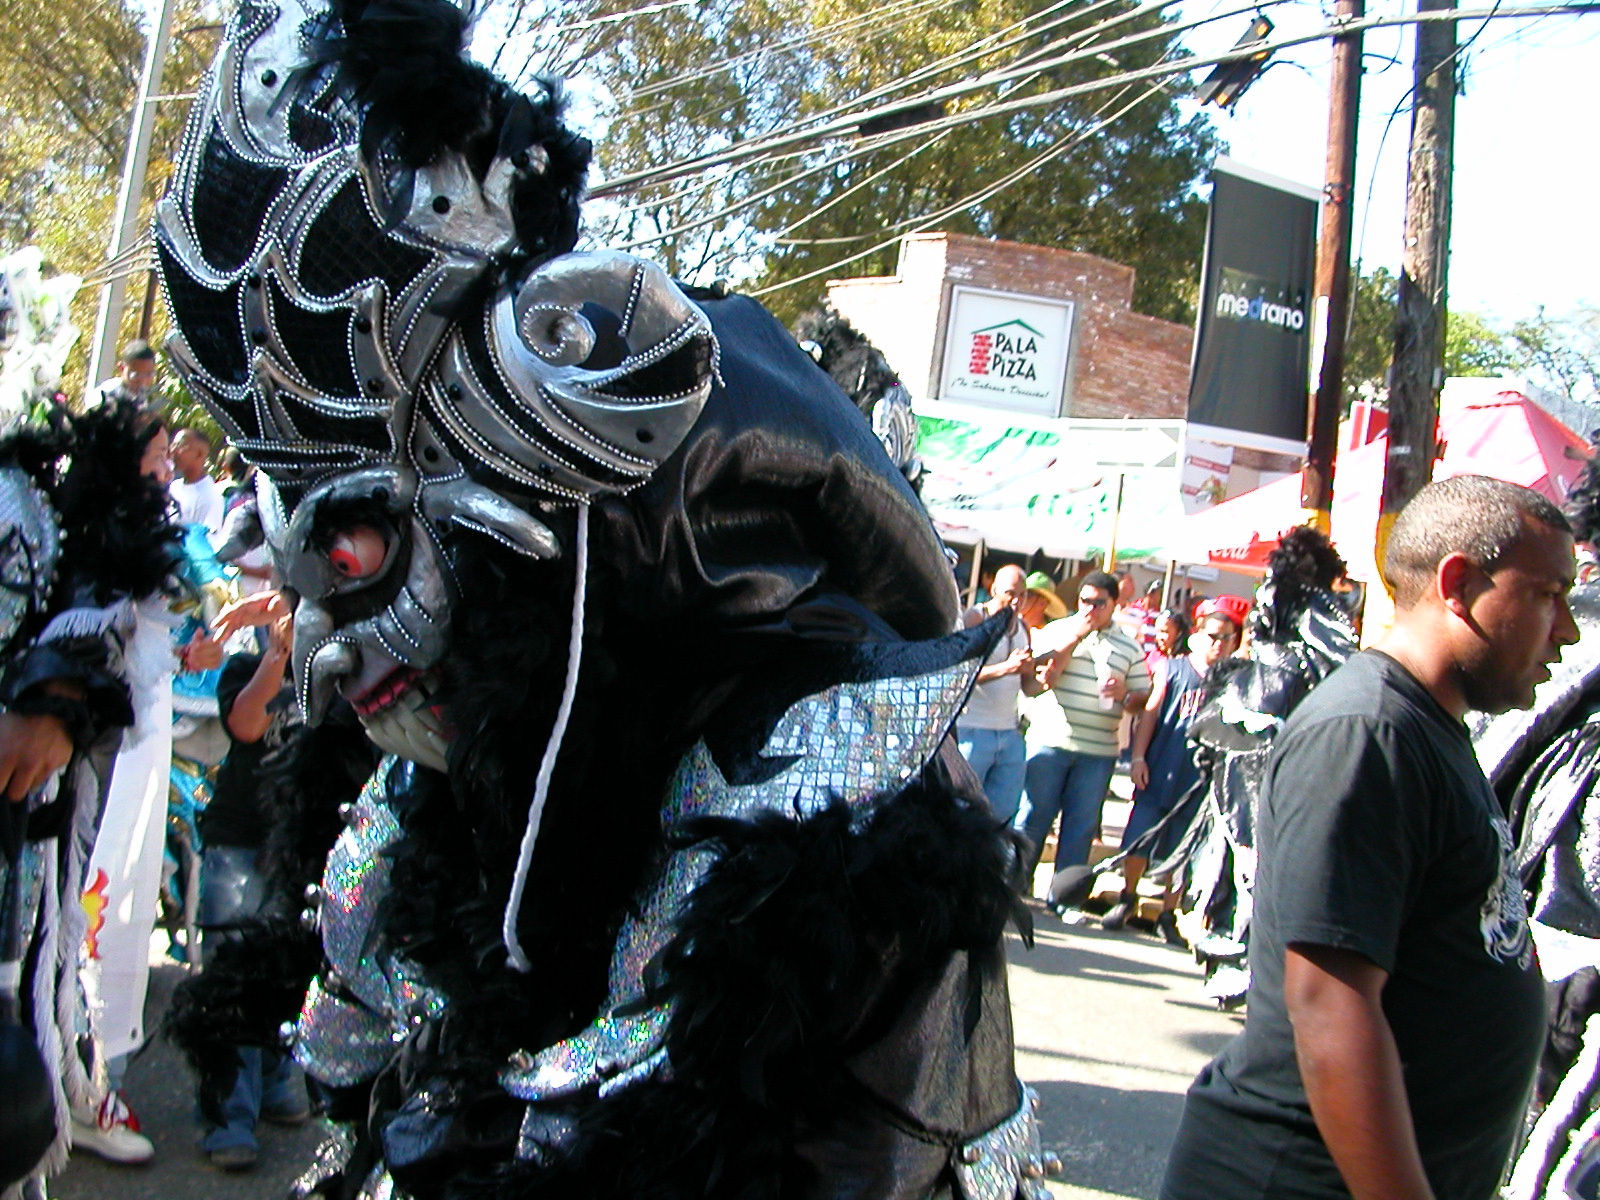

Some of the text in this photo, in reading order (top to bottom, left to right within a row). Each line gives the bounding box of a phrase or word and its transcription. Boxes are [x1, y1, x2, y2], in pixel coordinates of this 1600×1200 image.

[1216, 292, 1304, 330] medrano
[995, 332, 1037, 354] PALA
[992, 353, 1036, 381] PIZZA
